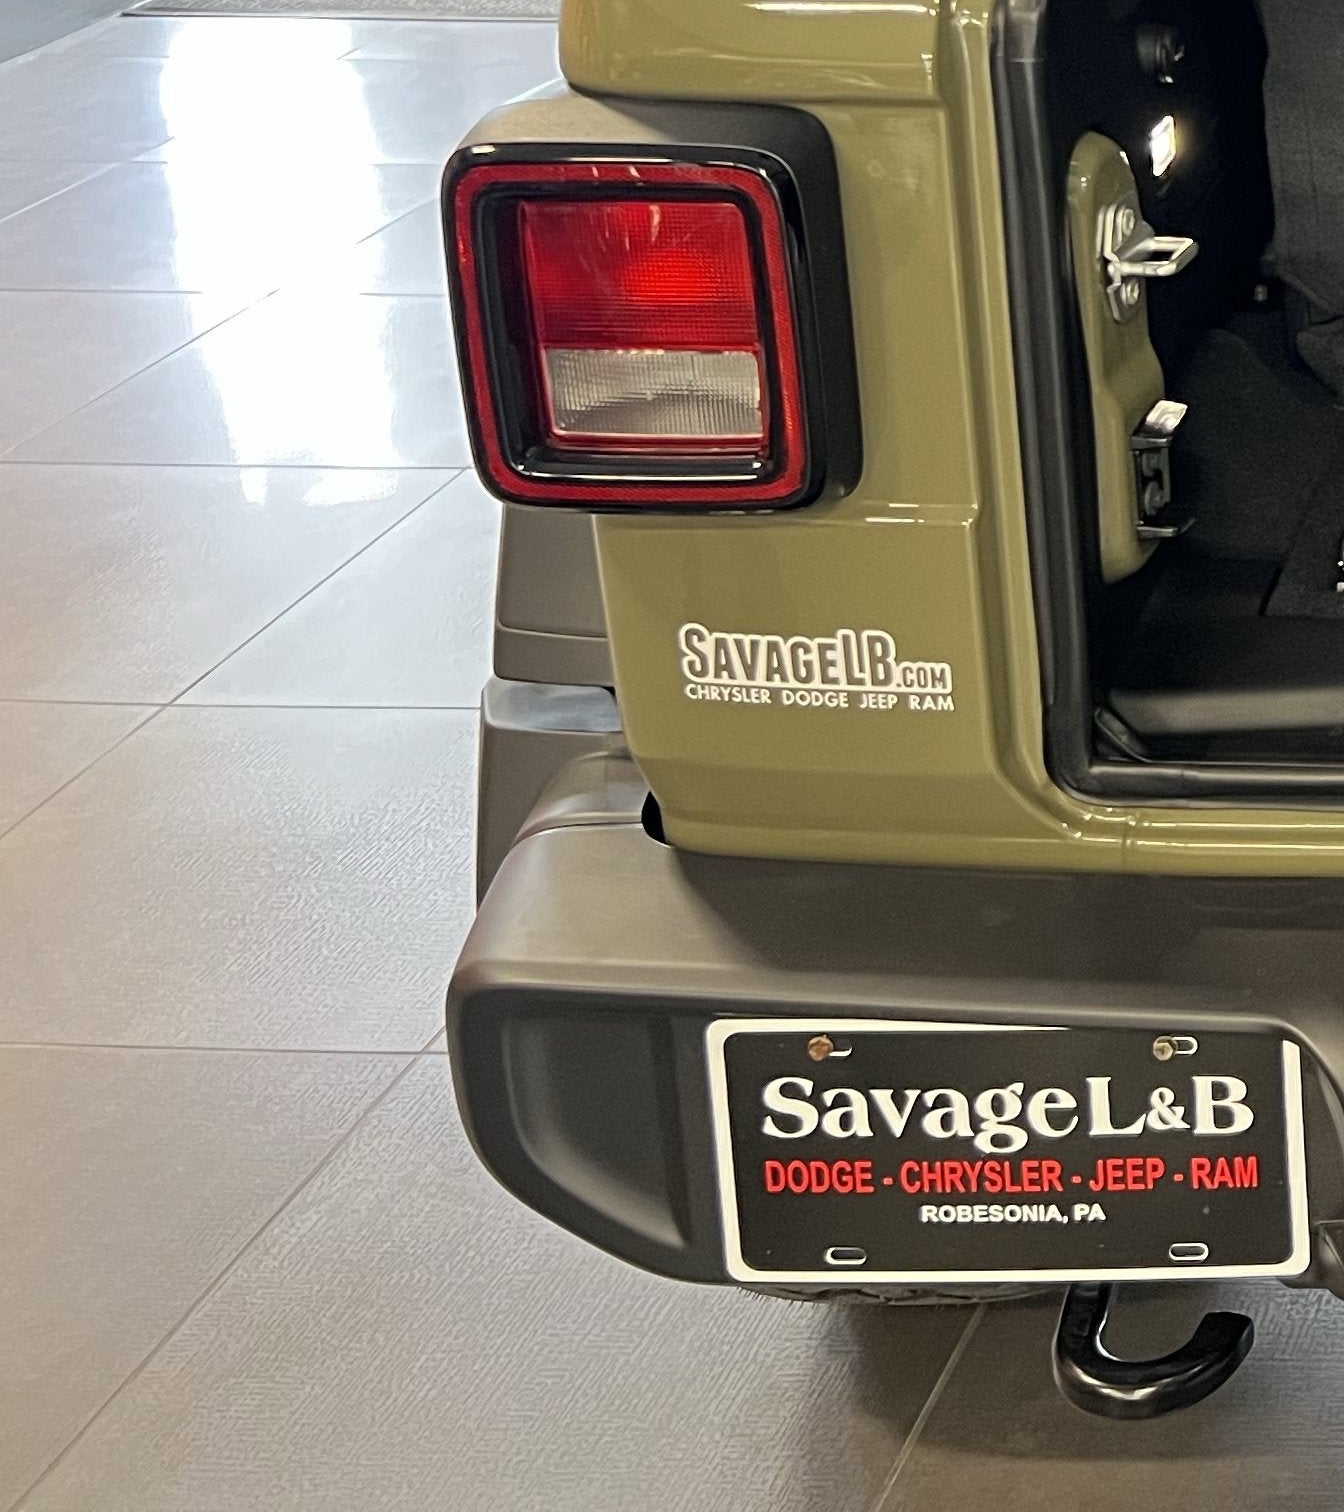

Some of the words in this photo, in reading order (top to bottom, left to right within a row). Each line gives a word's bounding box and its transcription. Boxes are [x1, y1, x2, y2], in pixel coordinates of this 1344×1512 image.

[685, 683, 772, 704] CHRYSLER
[781, 689, 849, 708] DODGE
[859, 693, 898, 709] JEEP
[909, 695, 955, 711] RAM
[764, 1160, 875, 1194] DODGE
[900, 1159, 1064, 1194] CHRYSLER
[1089, 1157, 1165, 1192] JEEP
[1191, 1155, 1259, 1189] RAM
[920, 1204, 1068, 1225] ROBESONIA,
[1074, 1202, 1107, 1223] PA
